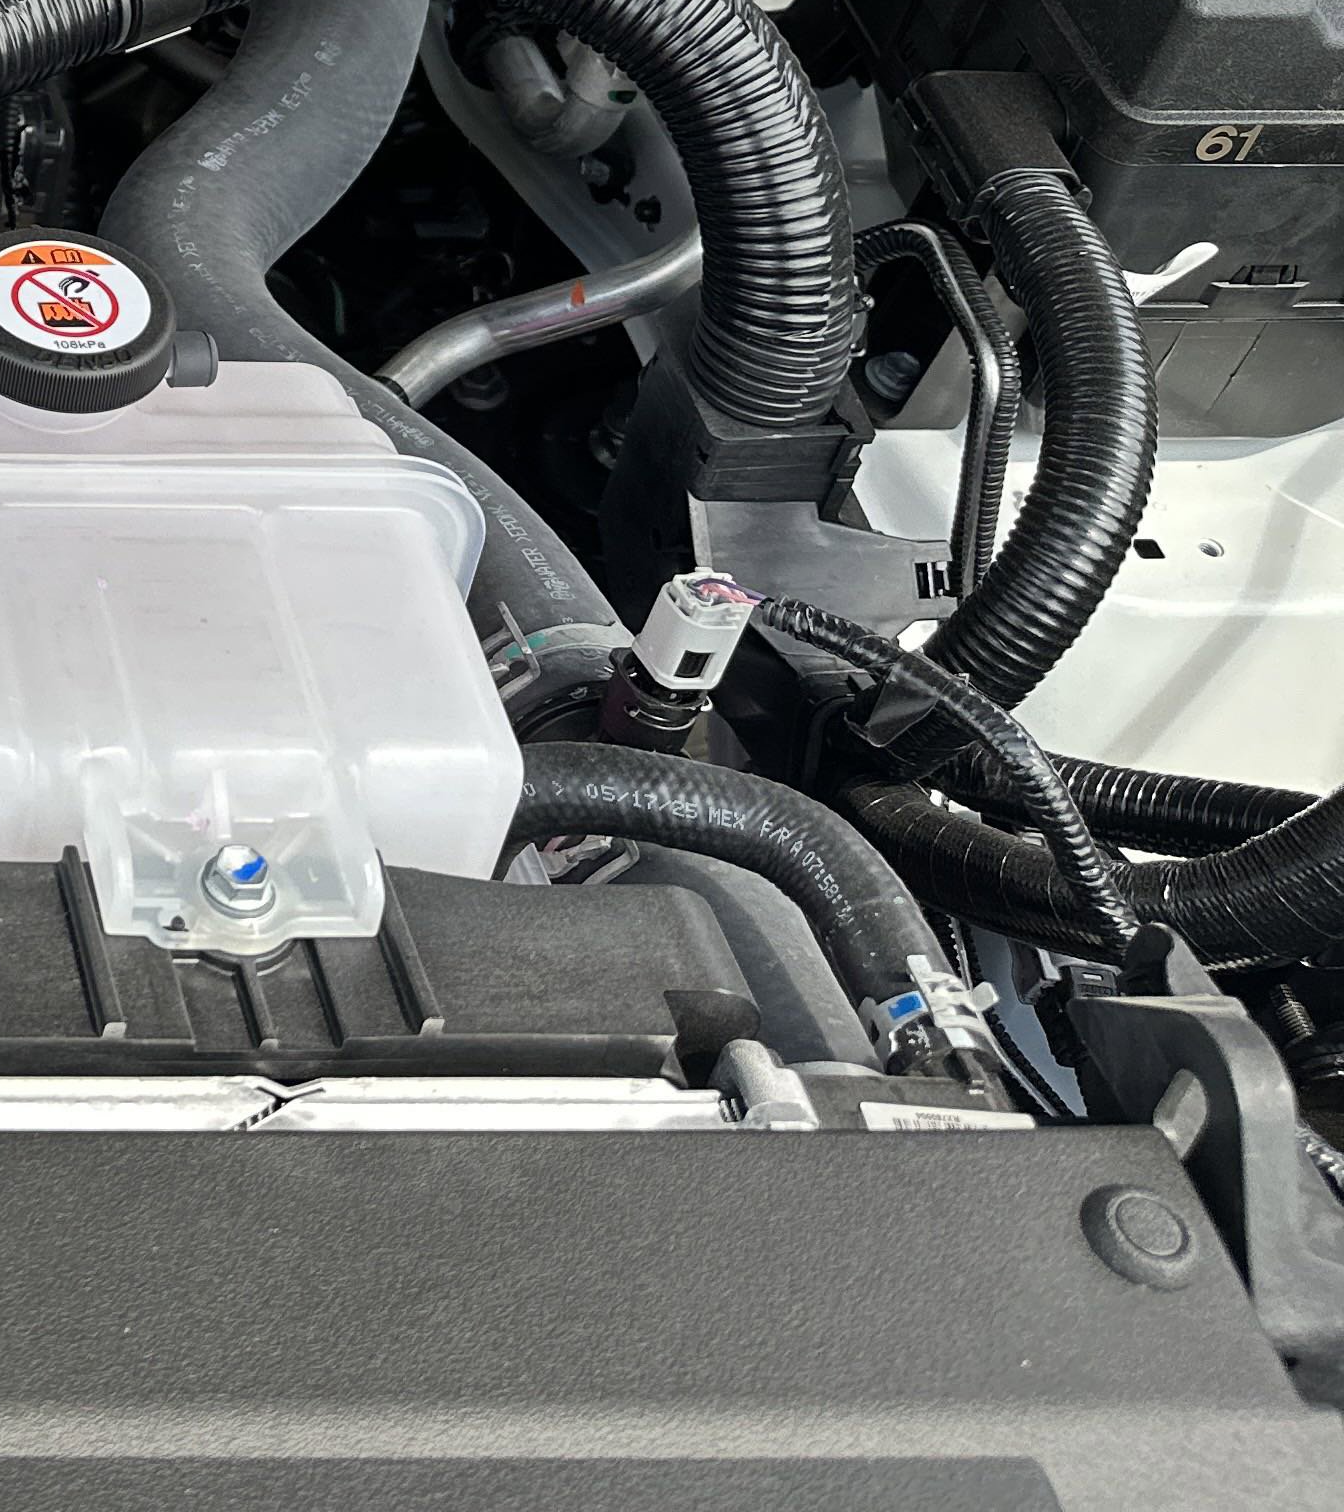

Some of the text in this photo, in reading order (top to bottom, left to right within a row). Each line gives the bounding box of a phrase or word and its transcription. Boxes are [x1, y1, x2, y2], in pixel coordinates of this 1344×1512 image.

[1195, 124, 1265, 162] 61
[53, 339, 107, 350] 108kPa
[586, 782, 699, 819] 05/17/25
[708, 805, 746, 830] MEX
